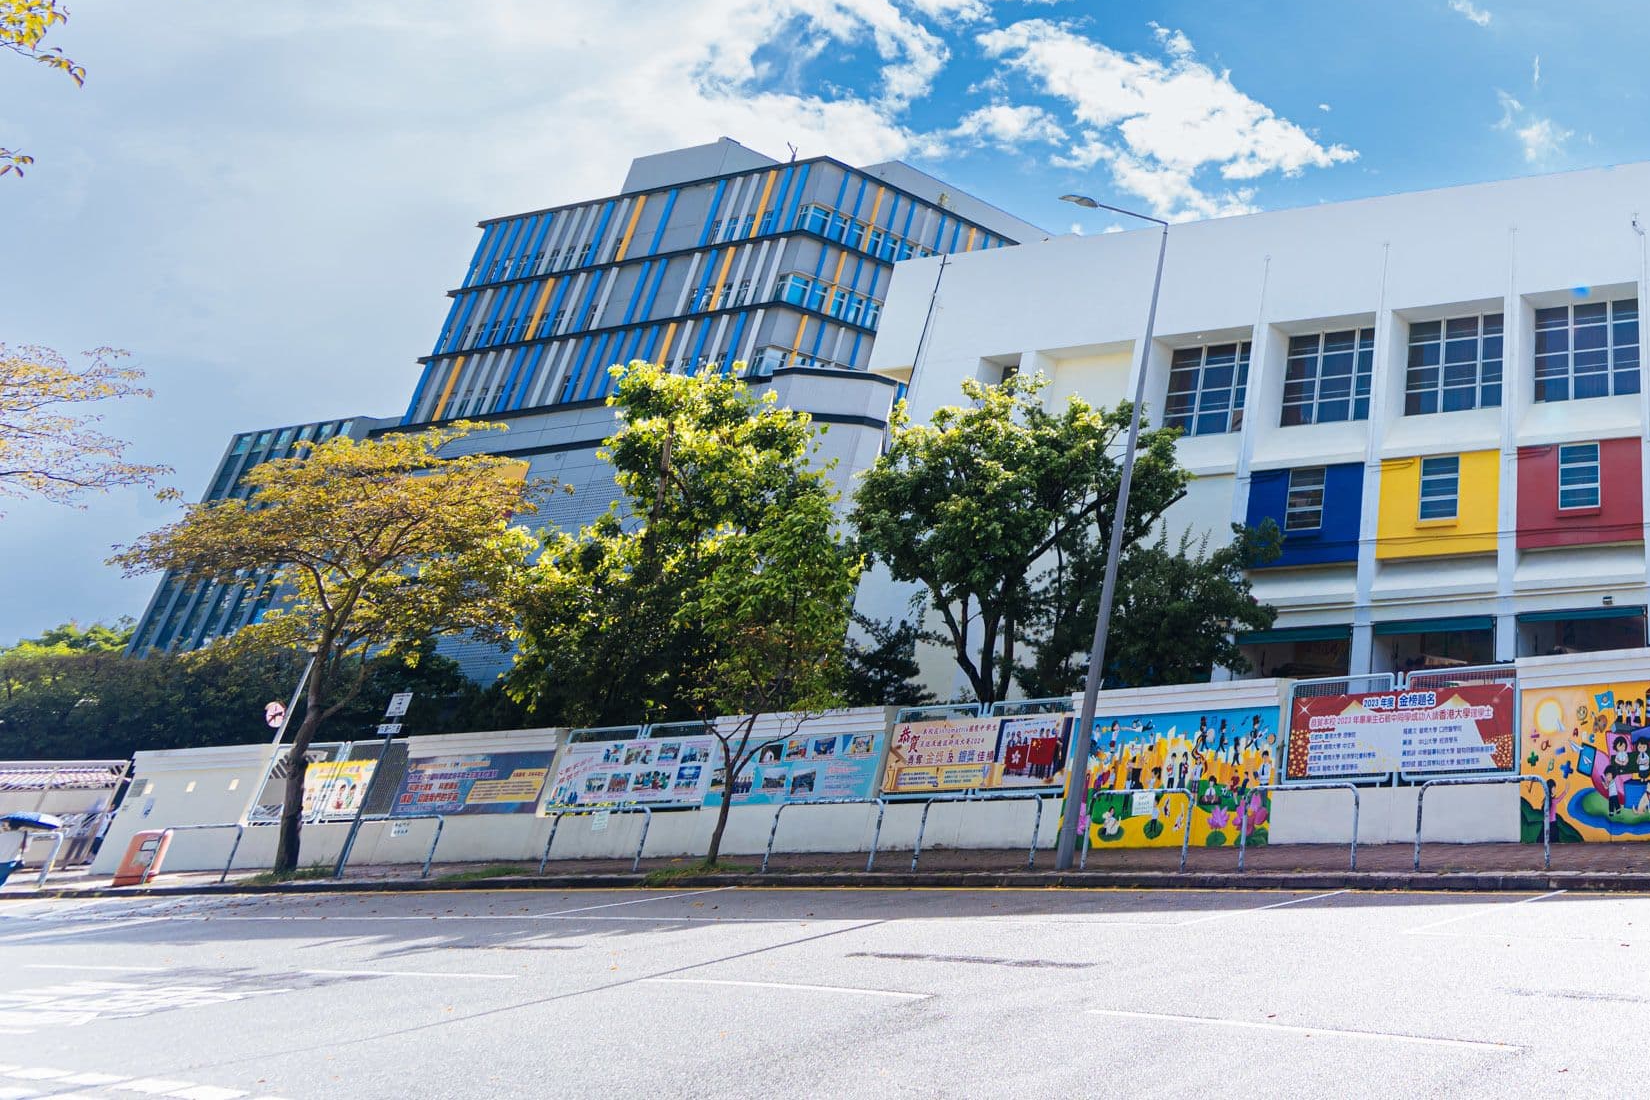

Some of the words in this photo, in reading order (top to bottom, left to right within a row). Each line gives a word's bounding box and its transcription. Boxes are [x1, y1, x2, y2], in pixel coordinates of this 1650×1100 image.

[1363, 698, 1379, 708] 2023
[1399, 693, 1435, 707] 金榜題名
